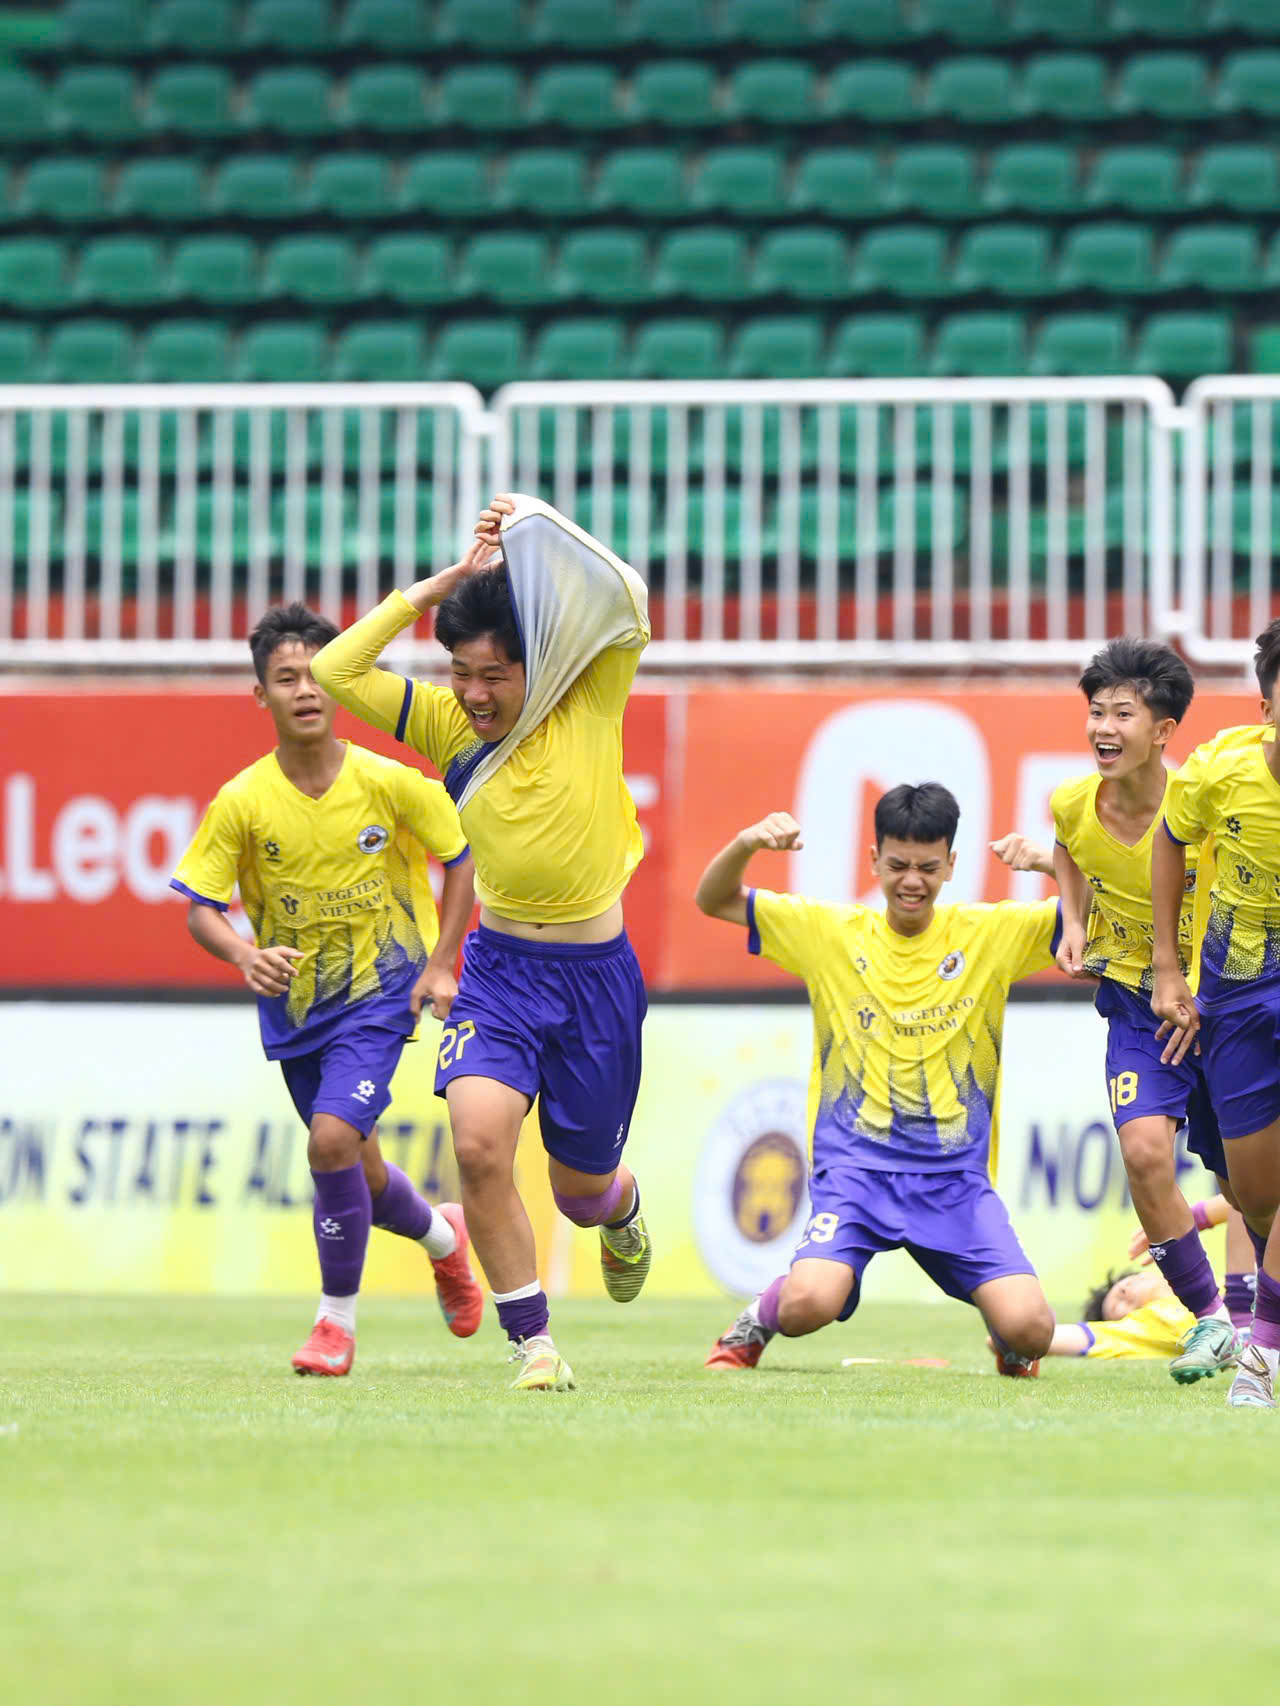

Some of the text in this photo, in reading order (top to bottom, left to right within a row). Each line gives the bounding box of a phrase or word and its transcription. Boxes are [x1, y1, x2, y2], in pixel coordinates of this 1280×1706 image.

[320, 893, 383, 917] VIETNAM
[439, 1019, 476, 1071] 27
[894, 1017, 957, 1037] VIETNAM
[1109, 1070, 1139, 1114] 18
[70, 1117, 225, 1207] STATE
